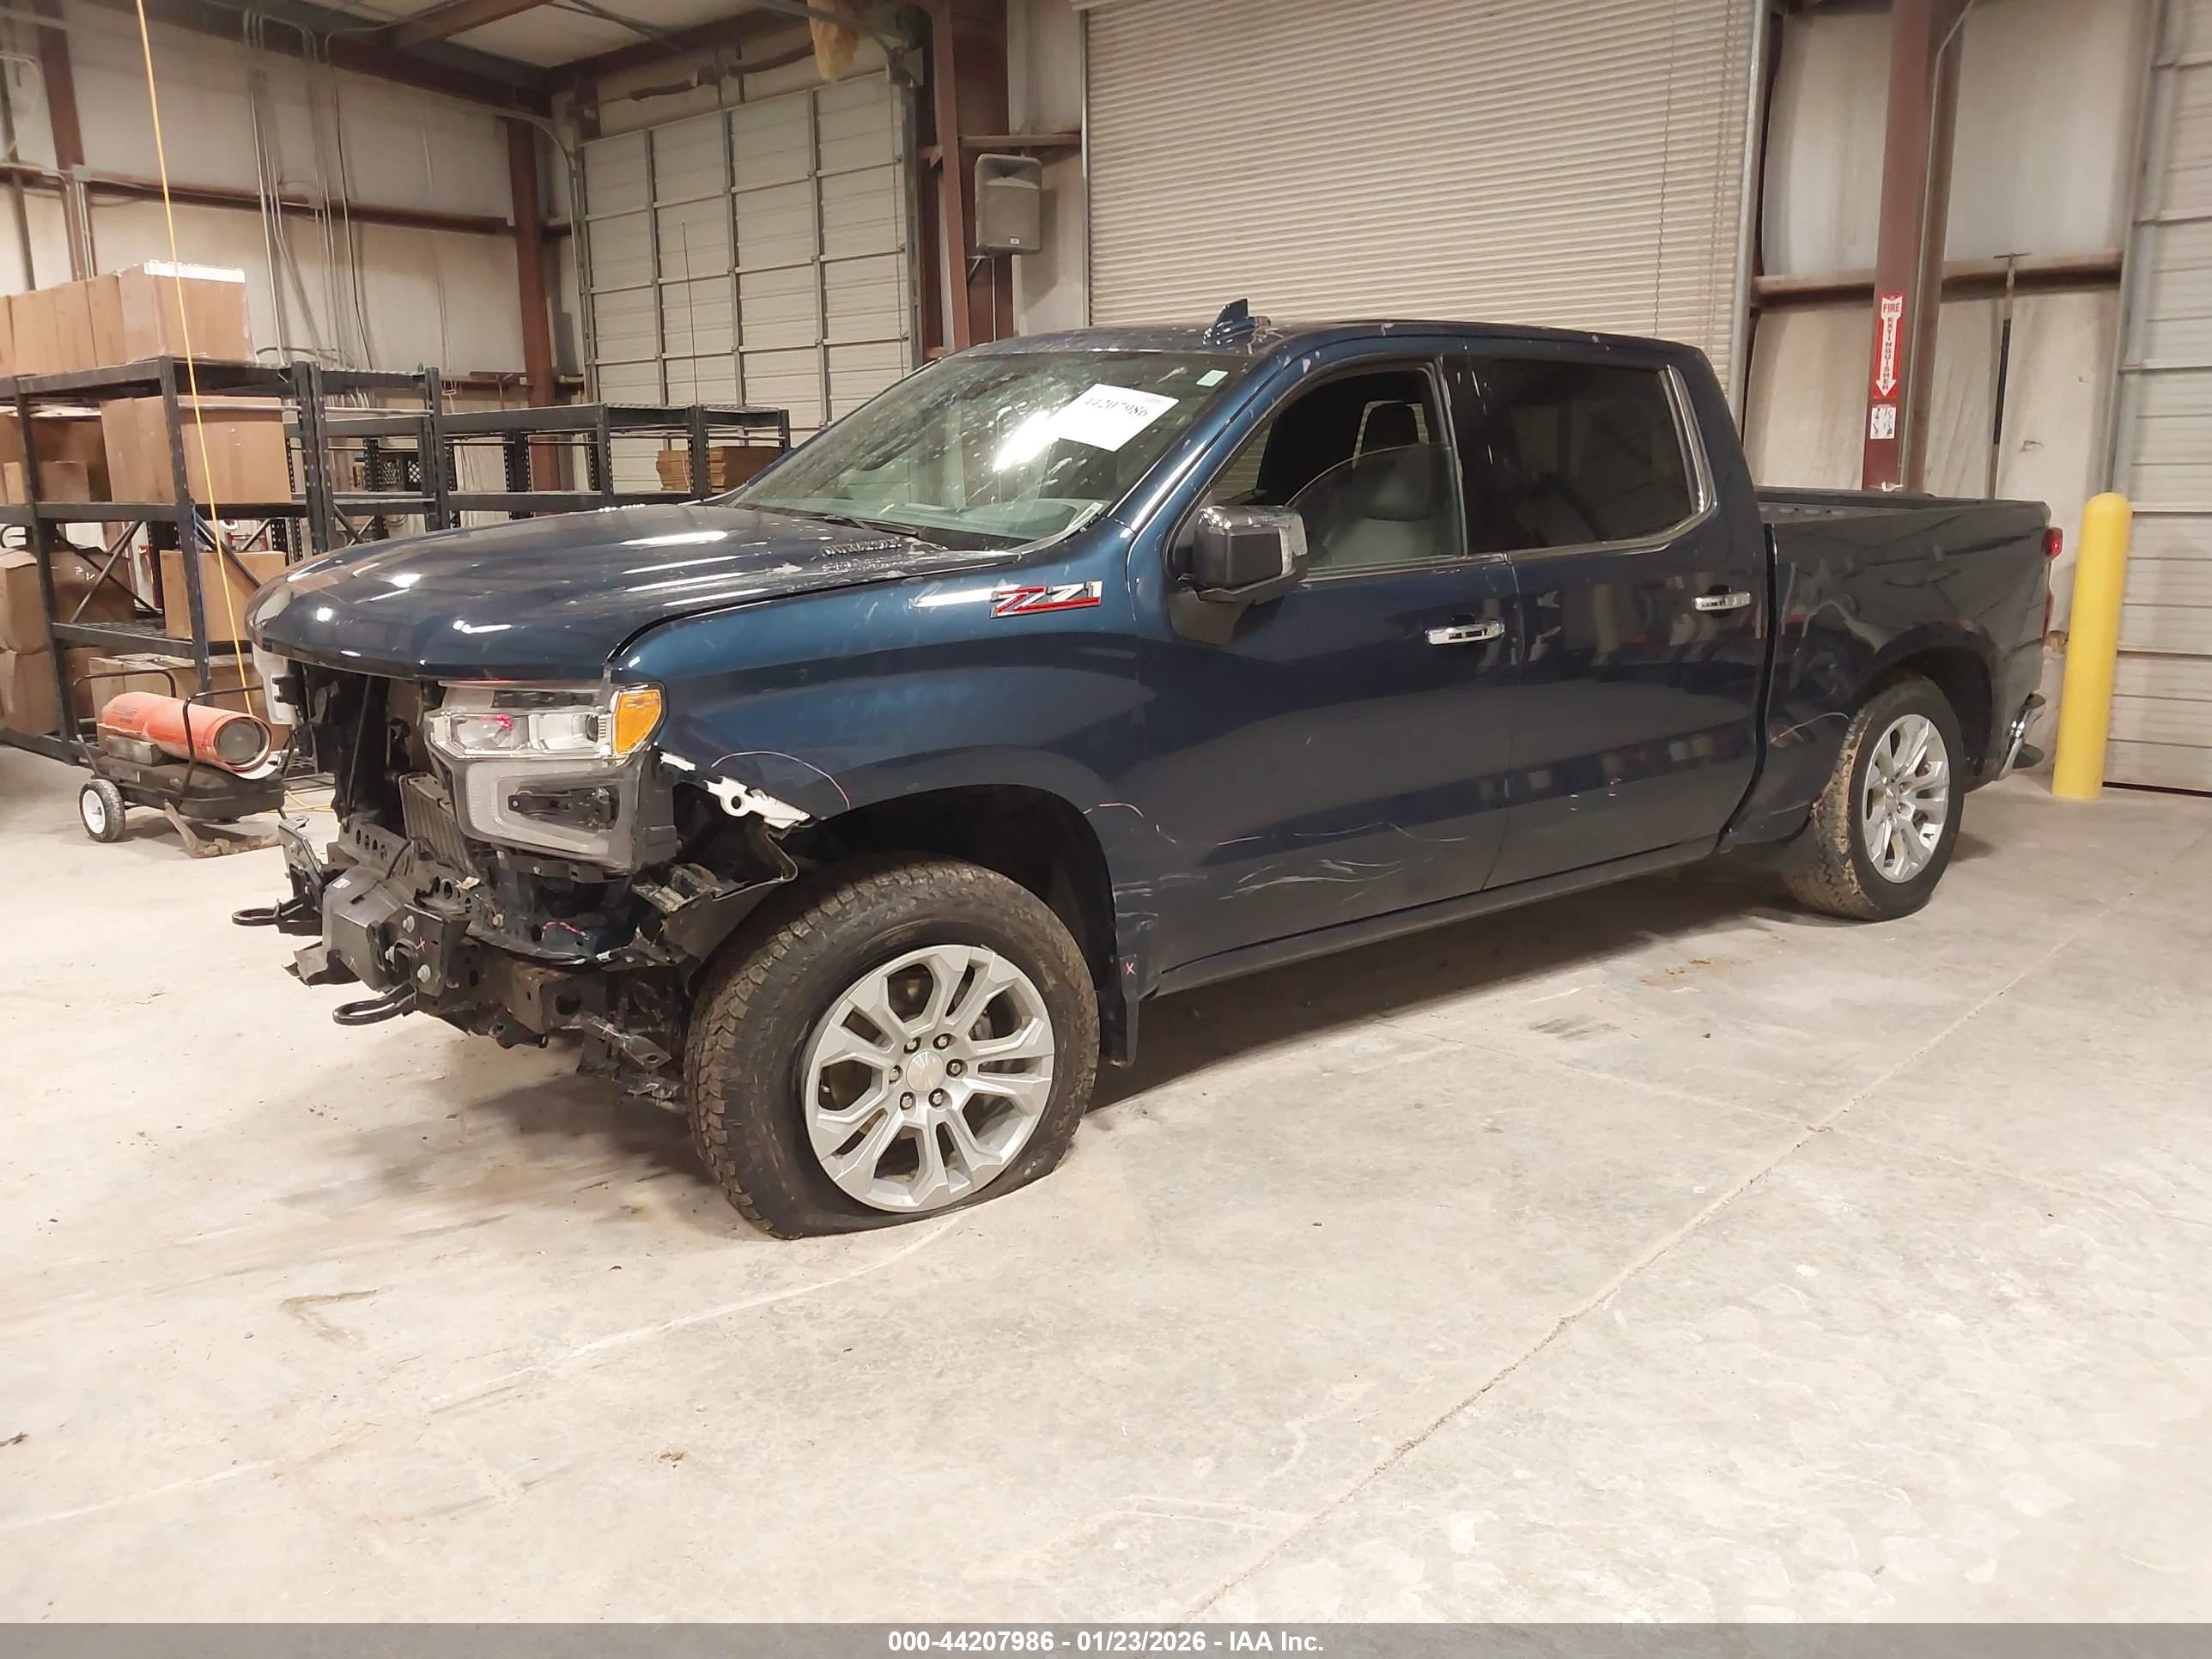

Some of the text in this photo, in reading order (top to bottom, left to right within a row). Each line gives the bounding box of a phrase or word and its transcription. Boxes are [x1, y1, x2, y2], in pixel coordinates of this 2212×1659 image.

[1883, 302, 1900, 313] FIRE
[1881, 317, 1893, 390] EXTINGUISHER
[989, 580, 1103, 619] Z71
